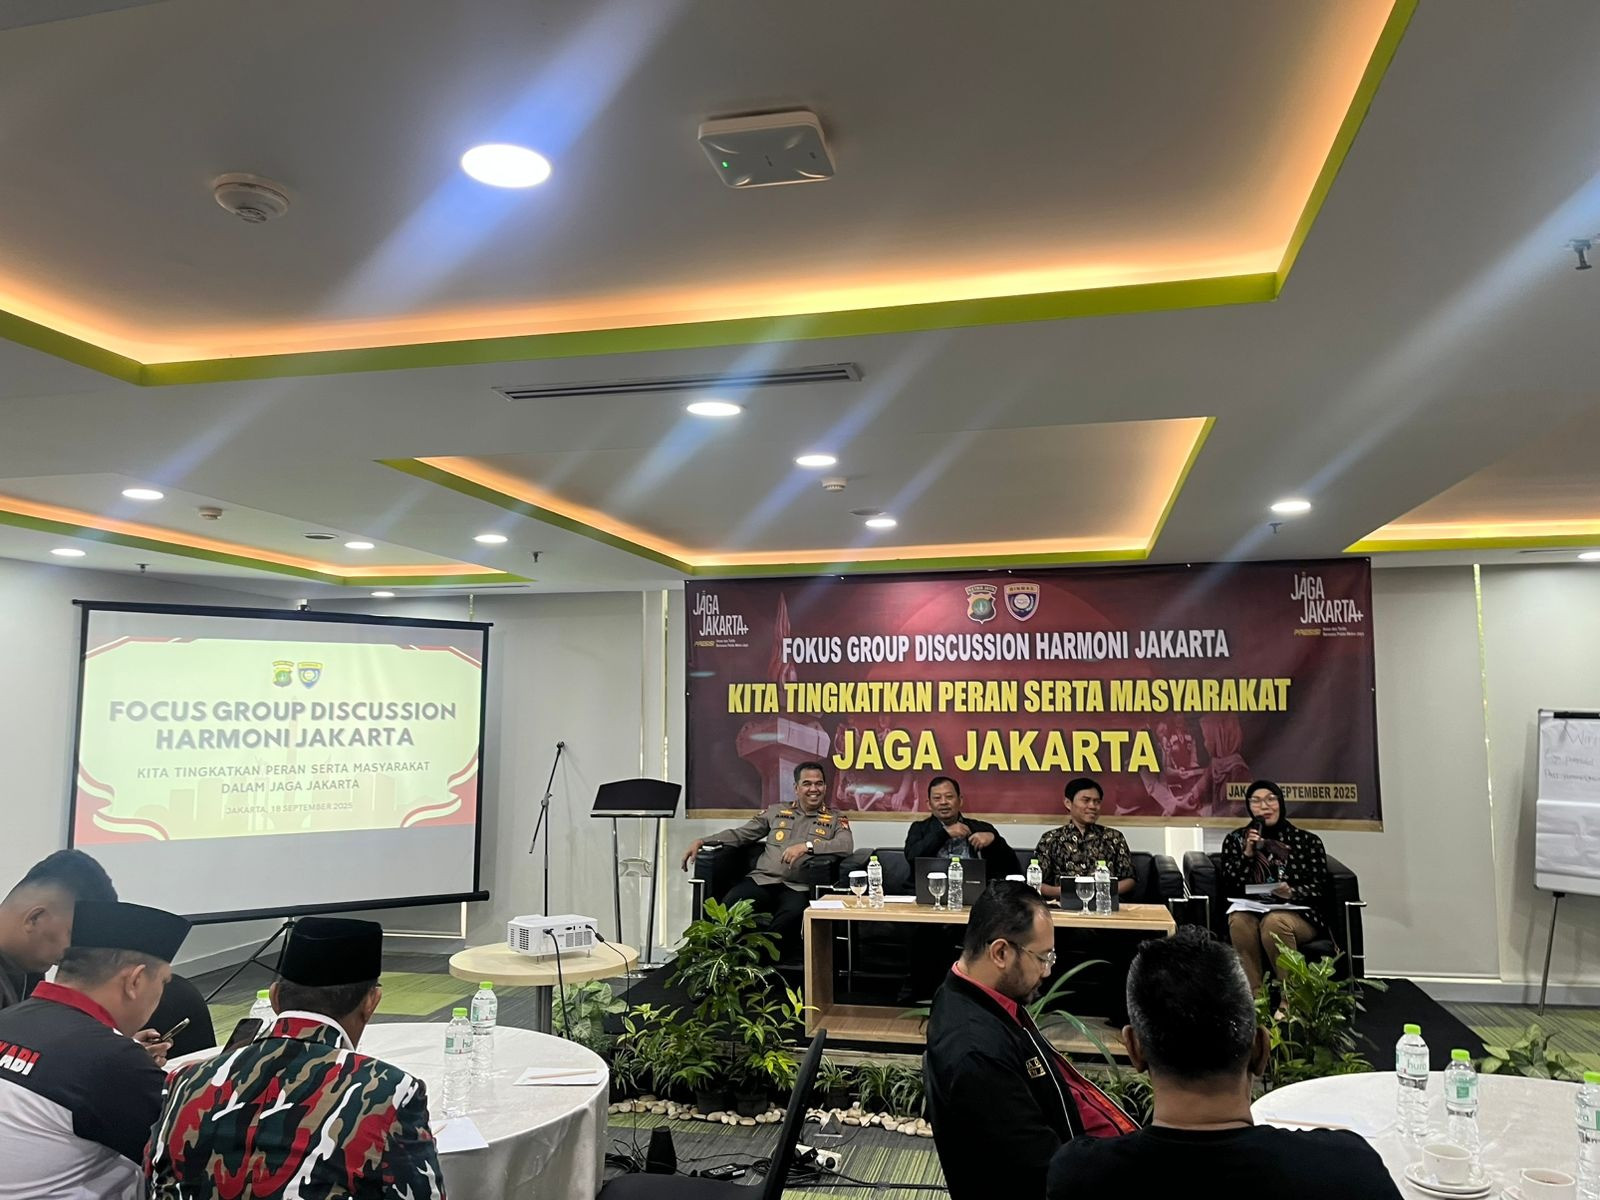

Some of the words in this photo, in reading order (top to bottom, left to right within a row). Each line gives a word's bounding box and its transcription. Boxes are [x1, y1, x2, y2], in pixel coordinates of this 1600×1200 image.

[782, 636, 842, 664] FOKUS
[847, 635, 910, 663] GROUP
[915, 633, 1029, 662] DISCUSSION
[1036, 631, 1128, 660] HARMONI
[1134, 629, 1230, 659] JAKARTA
[728, 683, 779, 713] KITA
[784, 681, 932, 713] TINGKATKAN
[938, 681, 1017, 712] PERAN
[1024, 680, 1104, 712] SERTA
[1111, 678, 1292, 712] MASYARAKAT
[109, 700, 207, 722] FOCUS
[212, 700, 306, 722] GROUP
[311, 701, 456, 721] DISCUSSION
[156, 728, 290, 750] HARMONI
[296, 726, 414, 748] JAKARTA
[832, 730, 943, 771] JAGA
[954, 730, 1160, 773] JAKARTA
[137, 767, 168, 779] KITA
[175, 765, 261, 778] TINGKATKAN
[265, 764, 306, 776] PERAN
[311, 763, 349, 775] SERTA
[353, 761, 430, 774] MASYARAKAT
[221, 782, 265, 794] DALAM
[269, 781, 303, 793] JAGA
[306, 779, 360, 791] JAKARTA
[1281, 786, 1331, 799] EPTEMBER
[1333, 786, 1356, 799] 2025
[283, 803, 332, 812] SEPTEMBER
